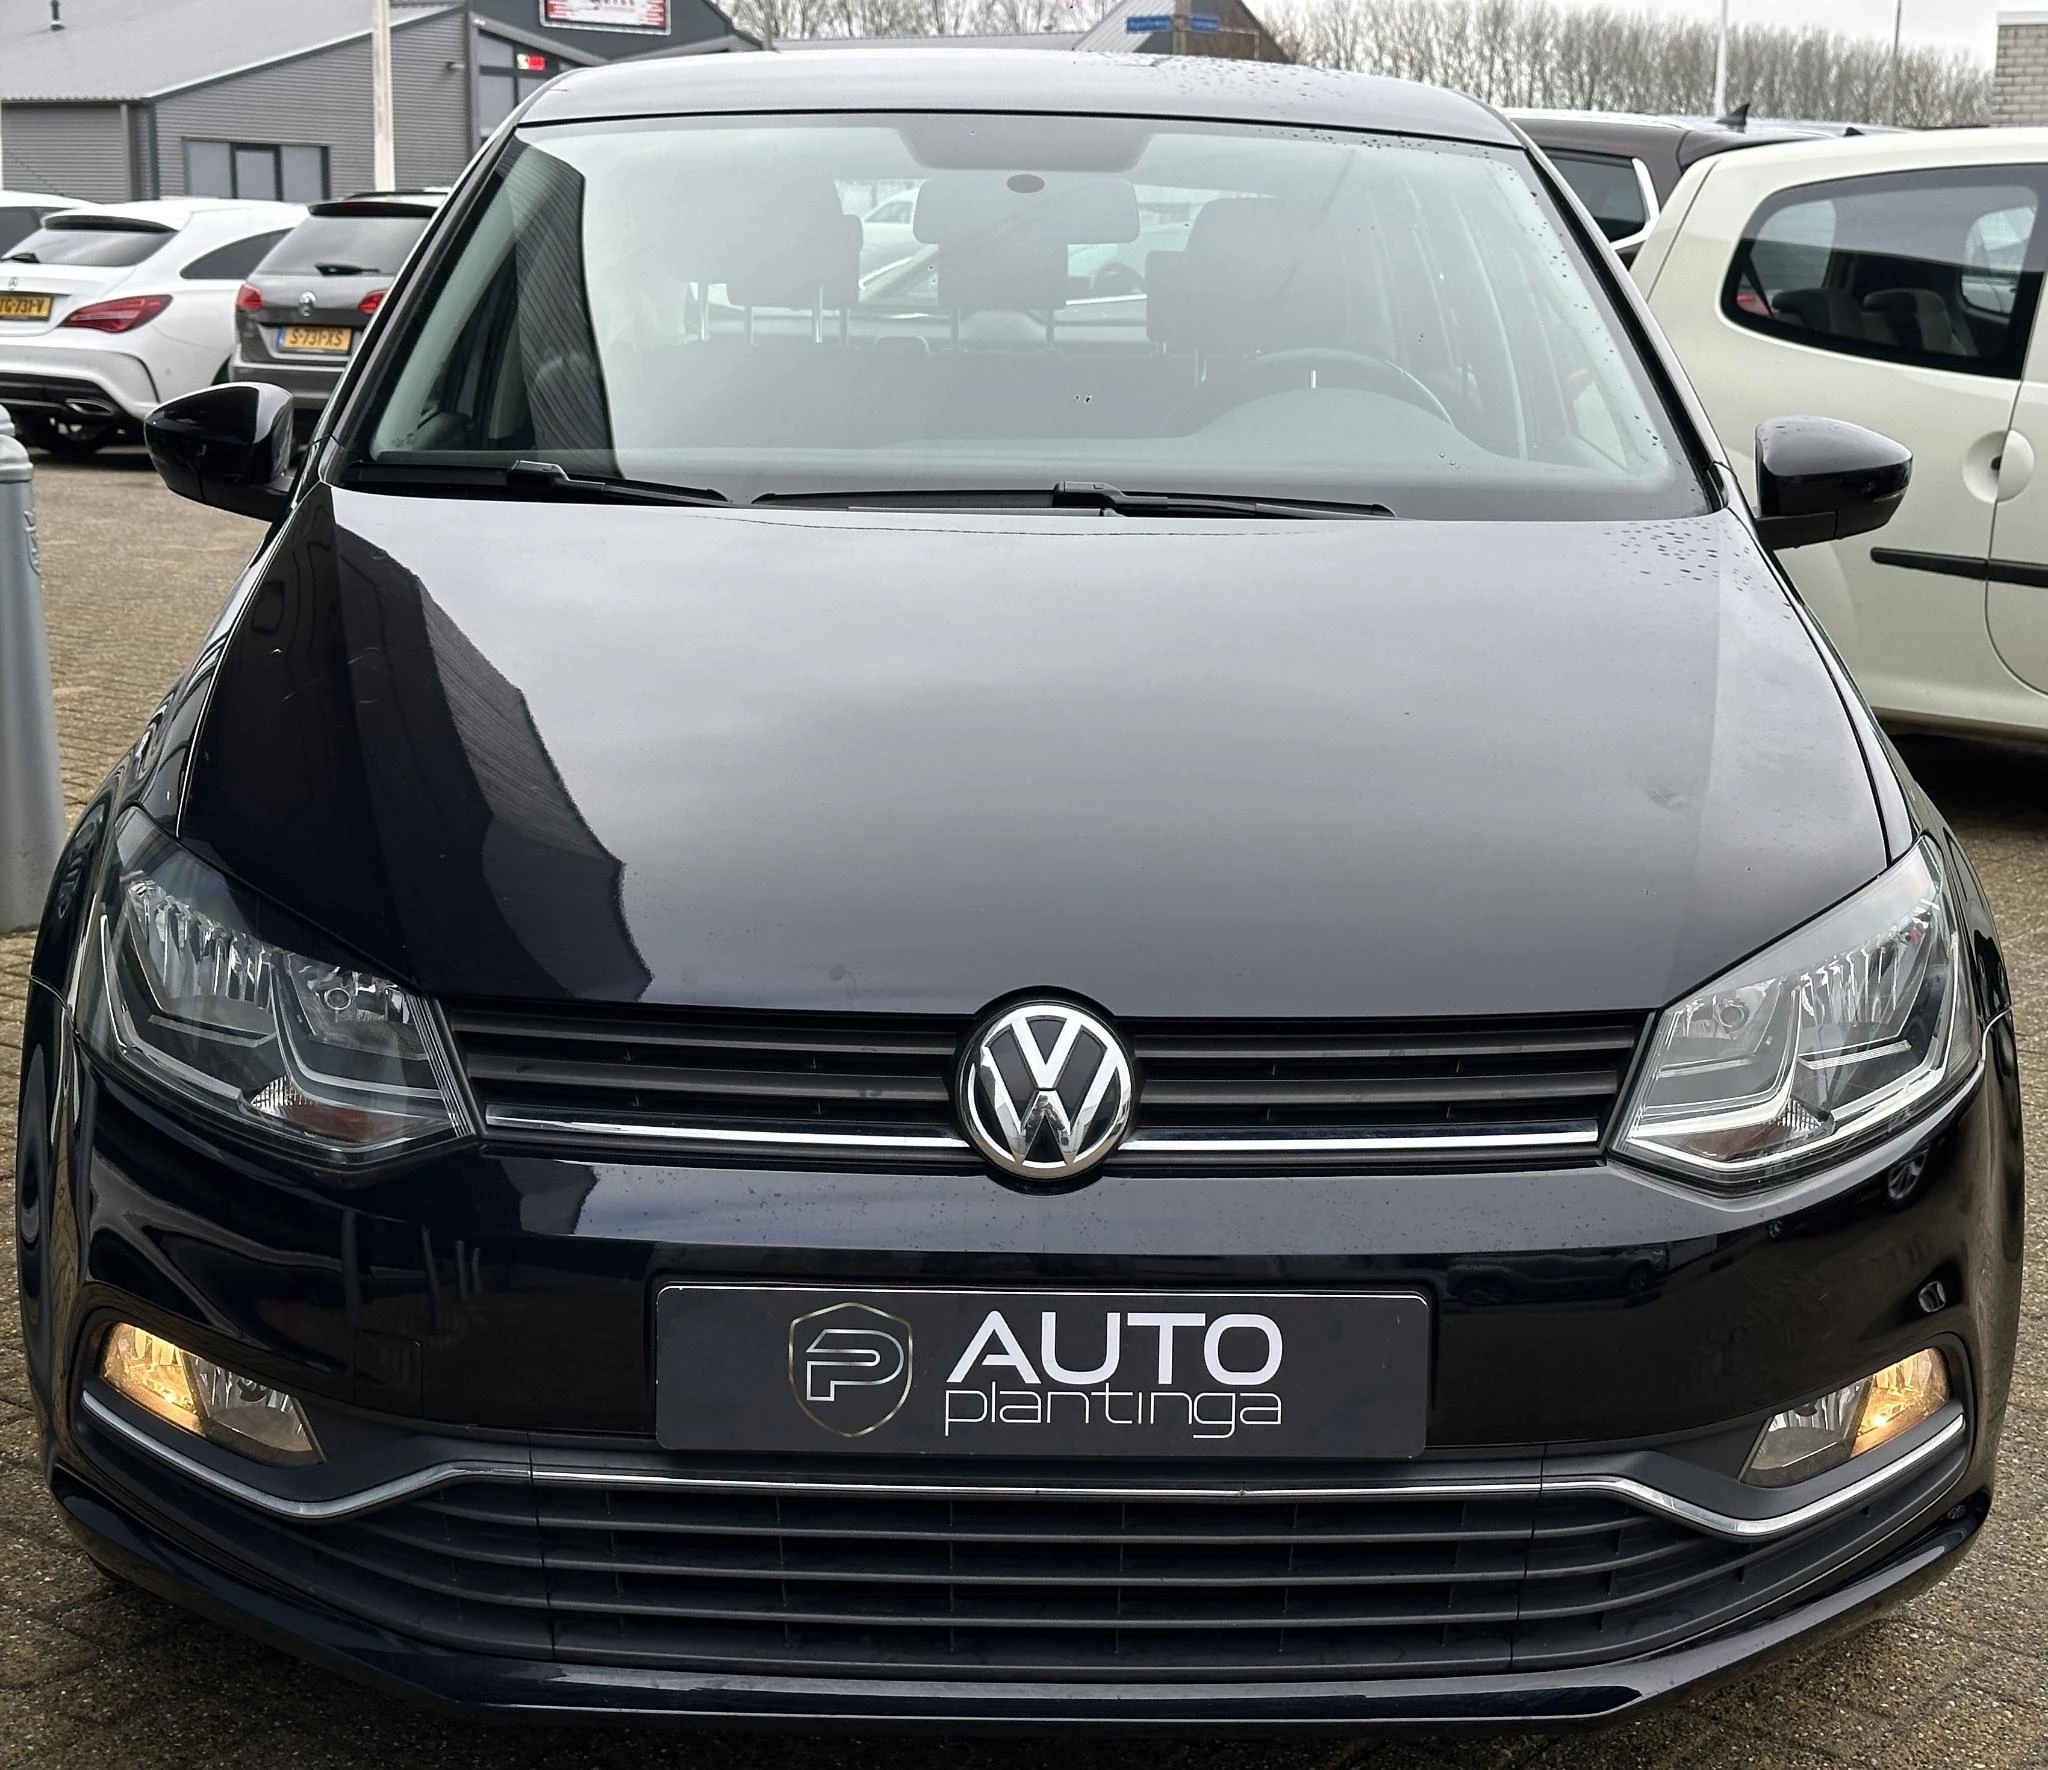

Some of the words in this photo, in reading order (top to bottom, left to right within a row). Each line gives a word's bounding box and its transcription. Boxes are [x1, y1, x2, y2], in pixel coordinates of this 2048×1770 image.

[289, 327, 344, 347] S-731-XS
[946, 1310, 1284, 1387] AUTO
[944, 1382, 1283, 1440] plantinga
